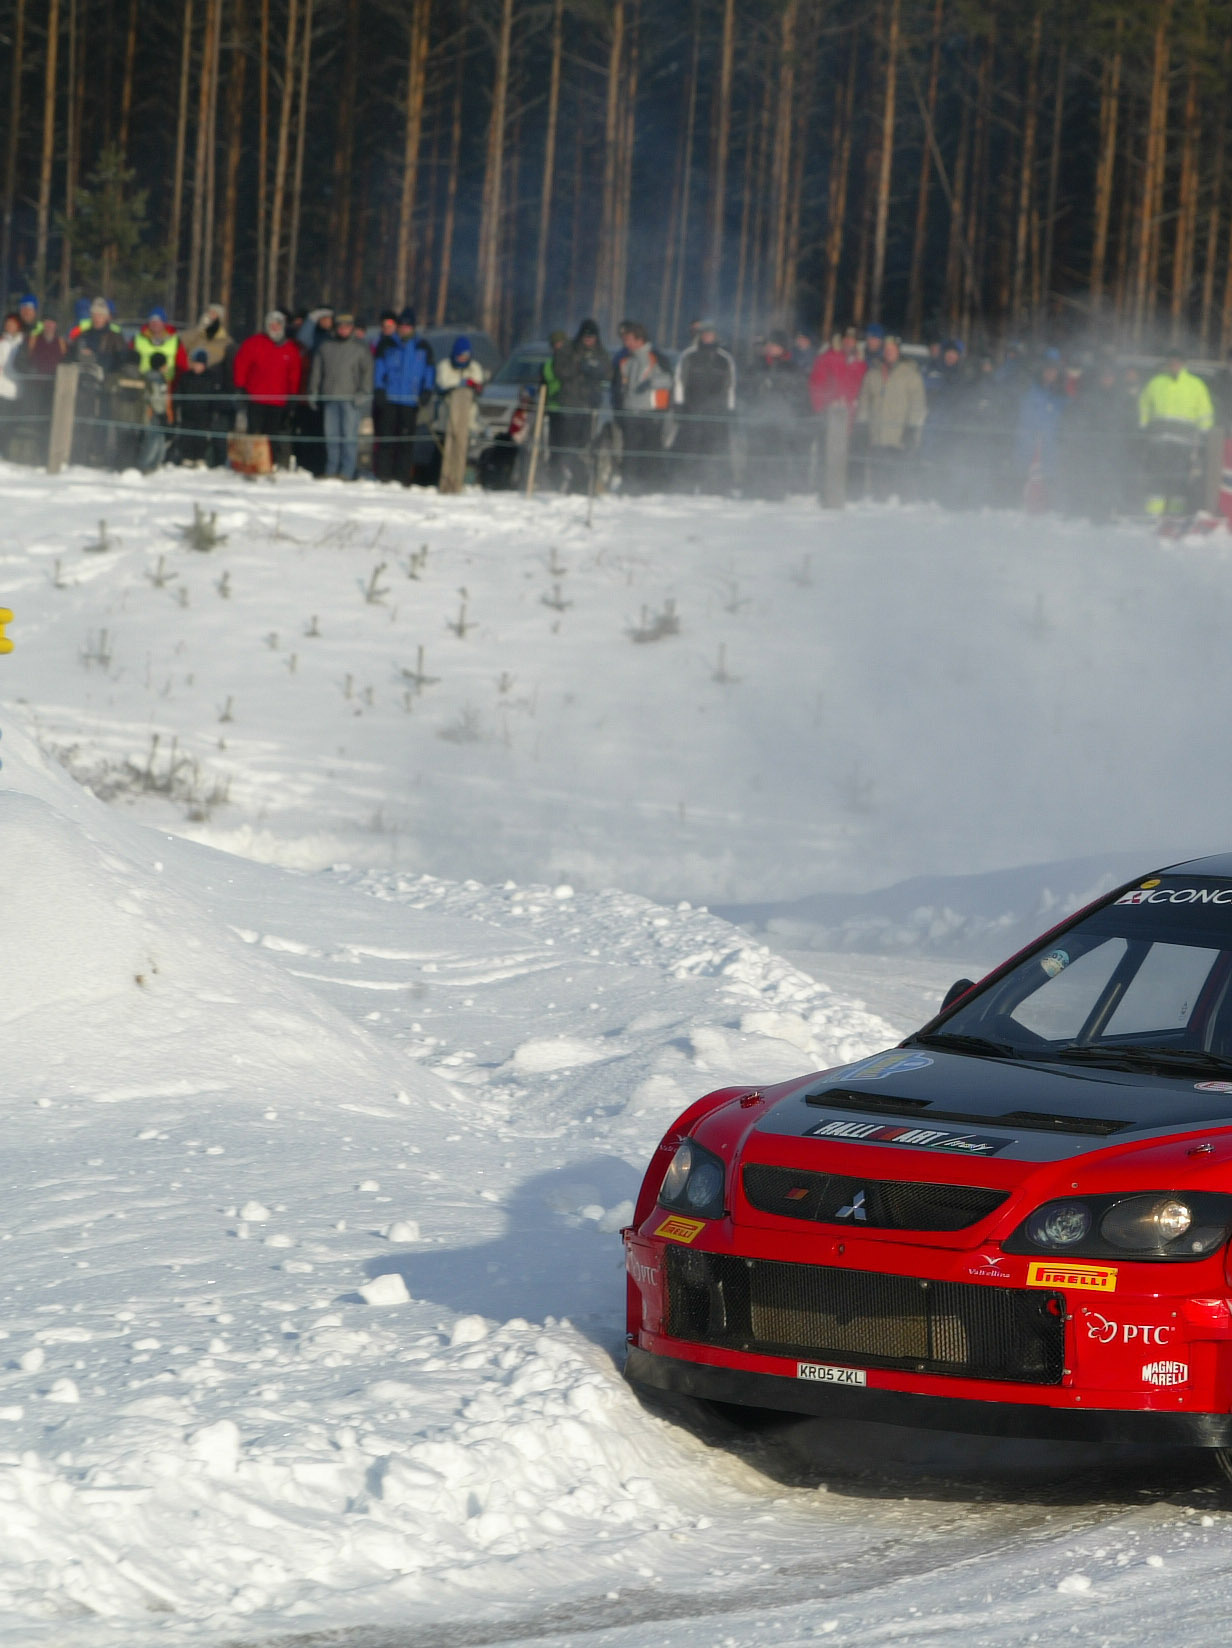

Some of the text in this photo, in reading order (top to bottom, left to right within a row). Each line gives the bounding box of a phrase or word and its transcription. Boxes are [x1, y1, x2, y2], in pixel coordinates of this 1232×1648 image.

[660, 1220, 697, 1239] PIRELLI
[1036, 1267, 1109, 1286] PIRELLI
[1122, 1325, 1170, 1344] PTC
[800, 1365, 862, 1384] KR05 ZKL
